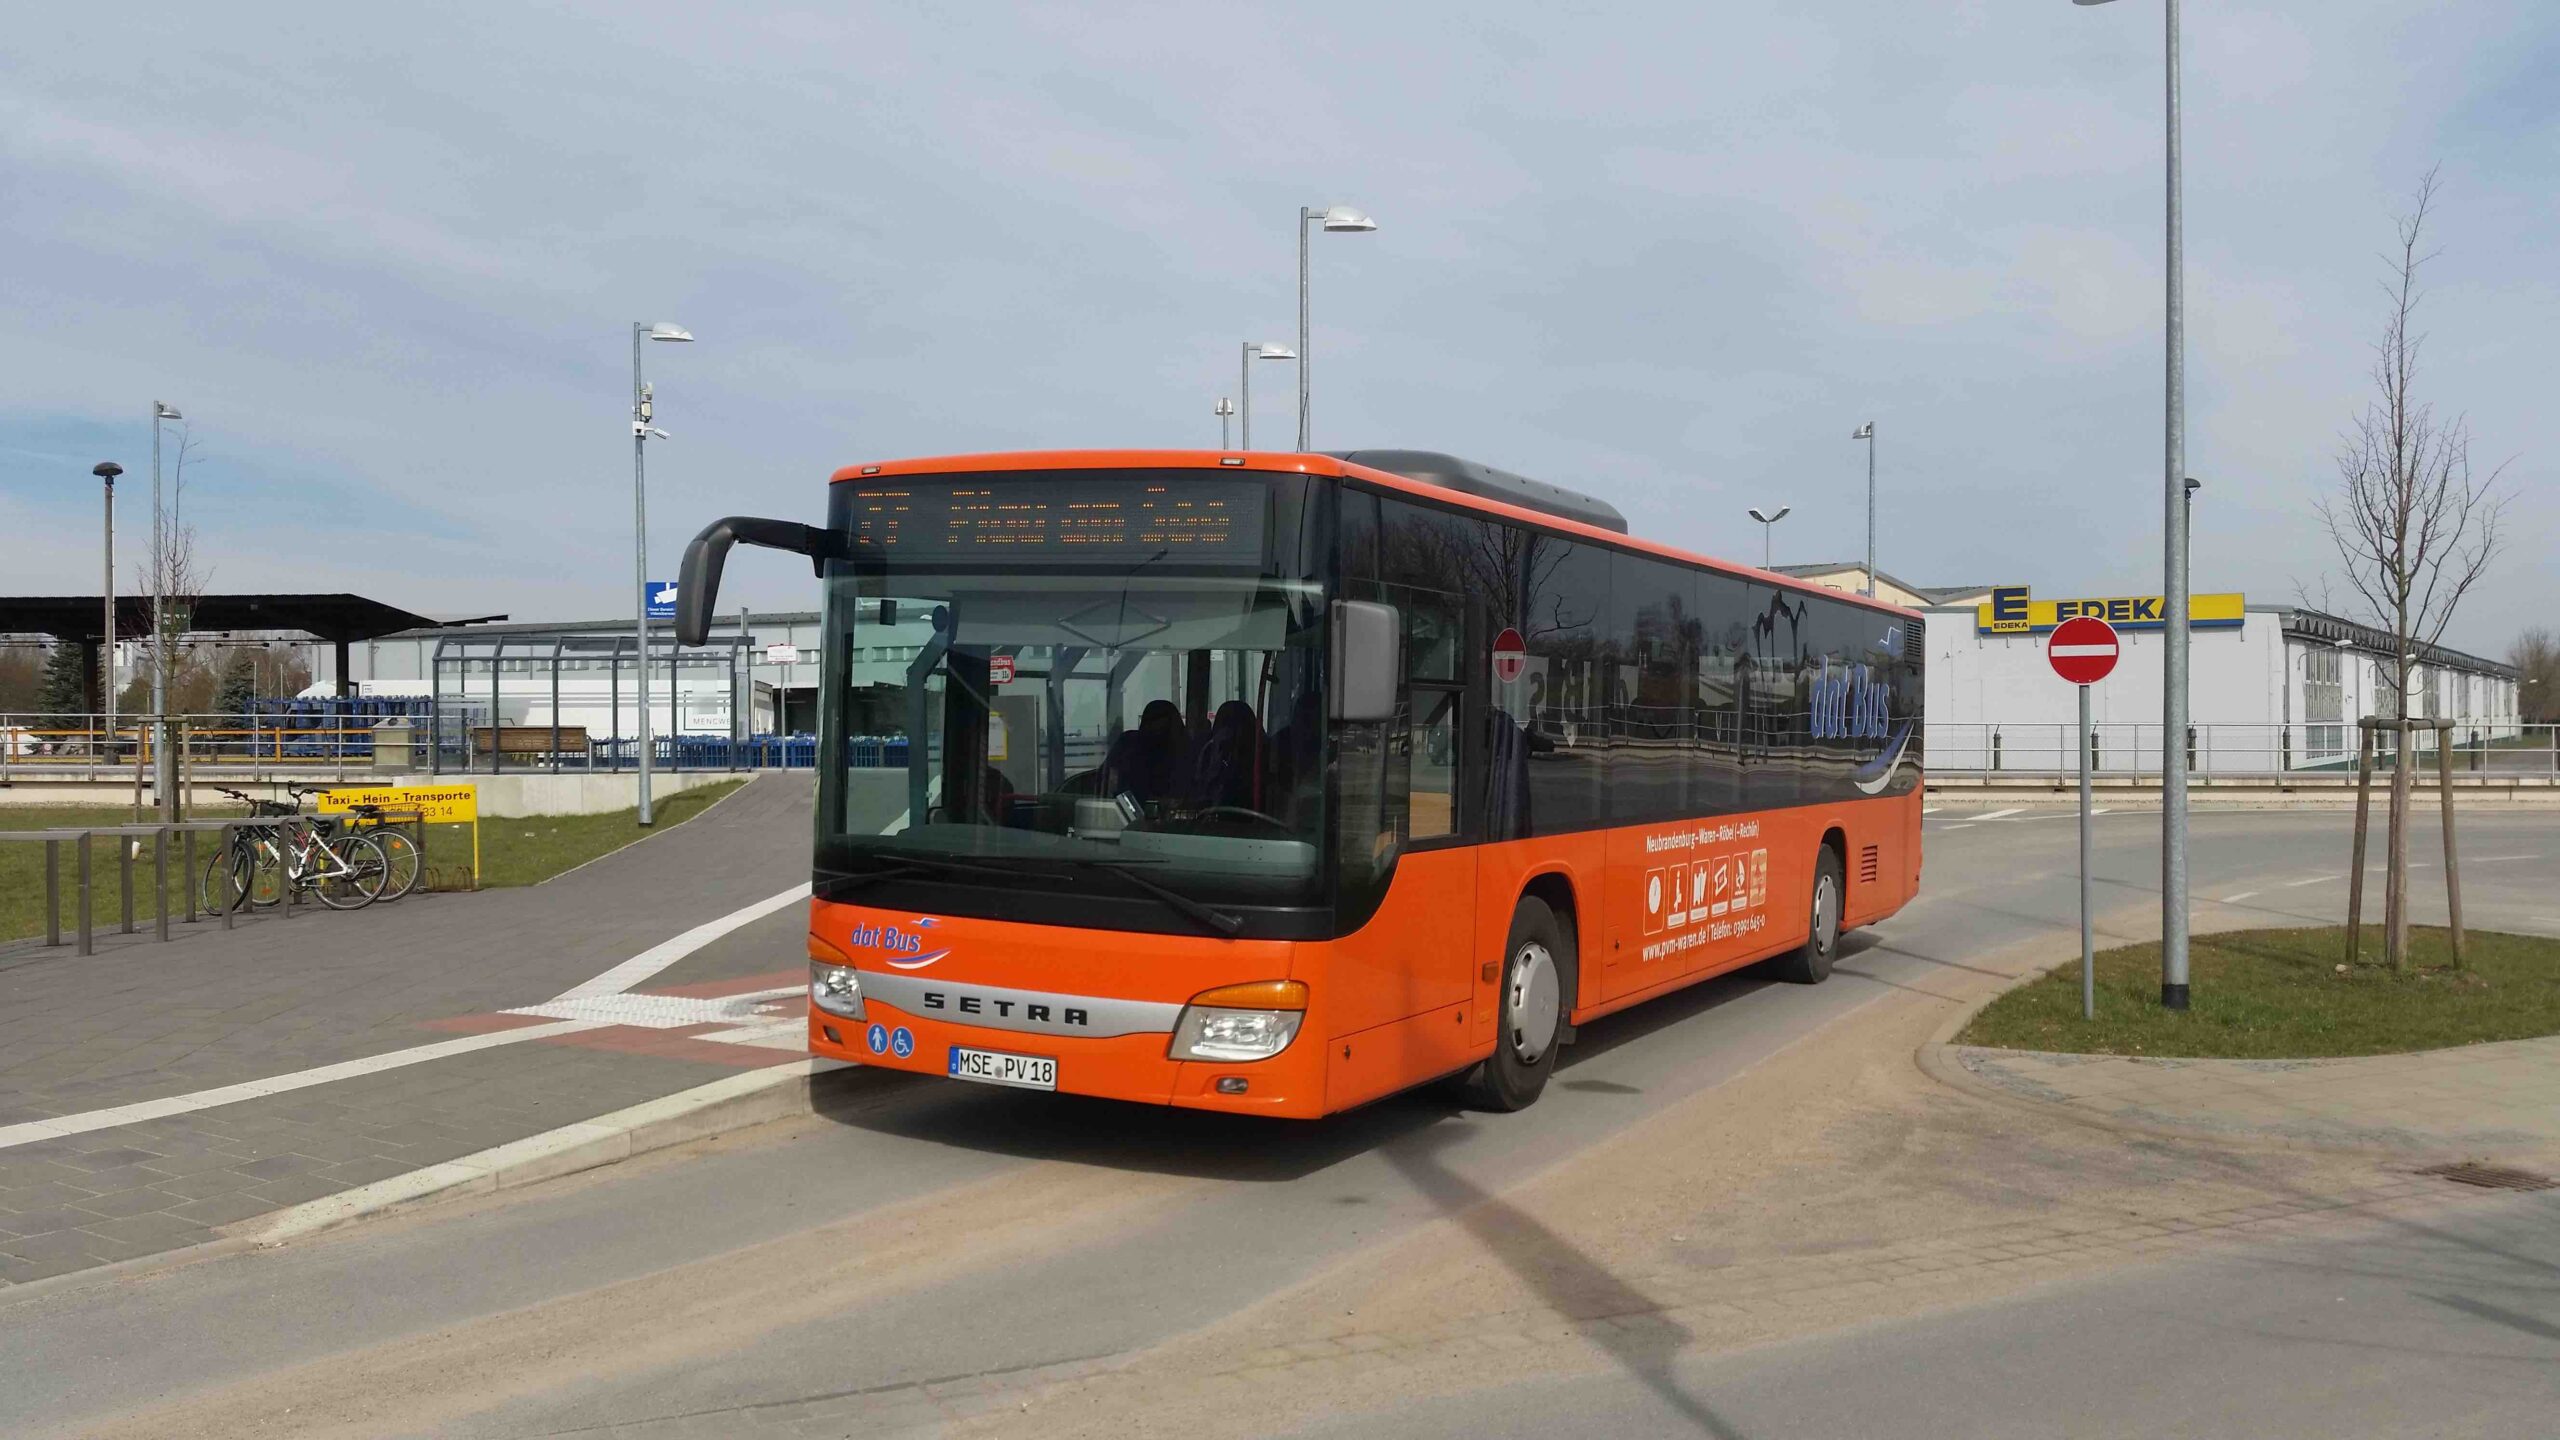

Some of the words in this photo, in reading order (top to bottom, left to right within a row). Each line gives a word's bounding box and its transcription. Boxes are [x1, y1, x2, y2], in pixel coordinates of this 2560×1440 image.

[1993, 621, 2029, 629] EDEKA
[1810, 654, 1850, 739] dat
[1851, 662, 1890, 739] Bus
[326, 795, 351, 806] Taxi
[362, 794, 390, 804] Hein
[403, 791, 471, 803] Transporte
[441, 806, 453, 817] 14
[852, 922, 881, 948] dat
[884, 926, 922, 953] Bus
[1711, 920, 1733, 941] Telefon:
[924, 992, 1088, 1026] SETRA
[959, 1052, 993, 1076] MSE
